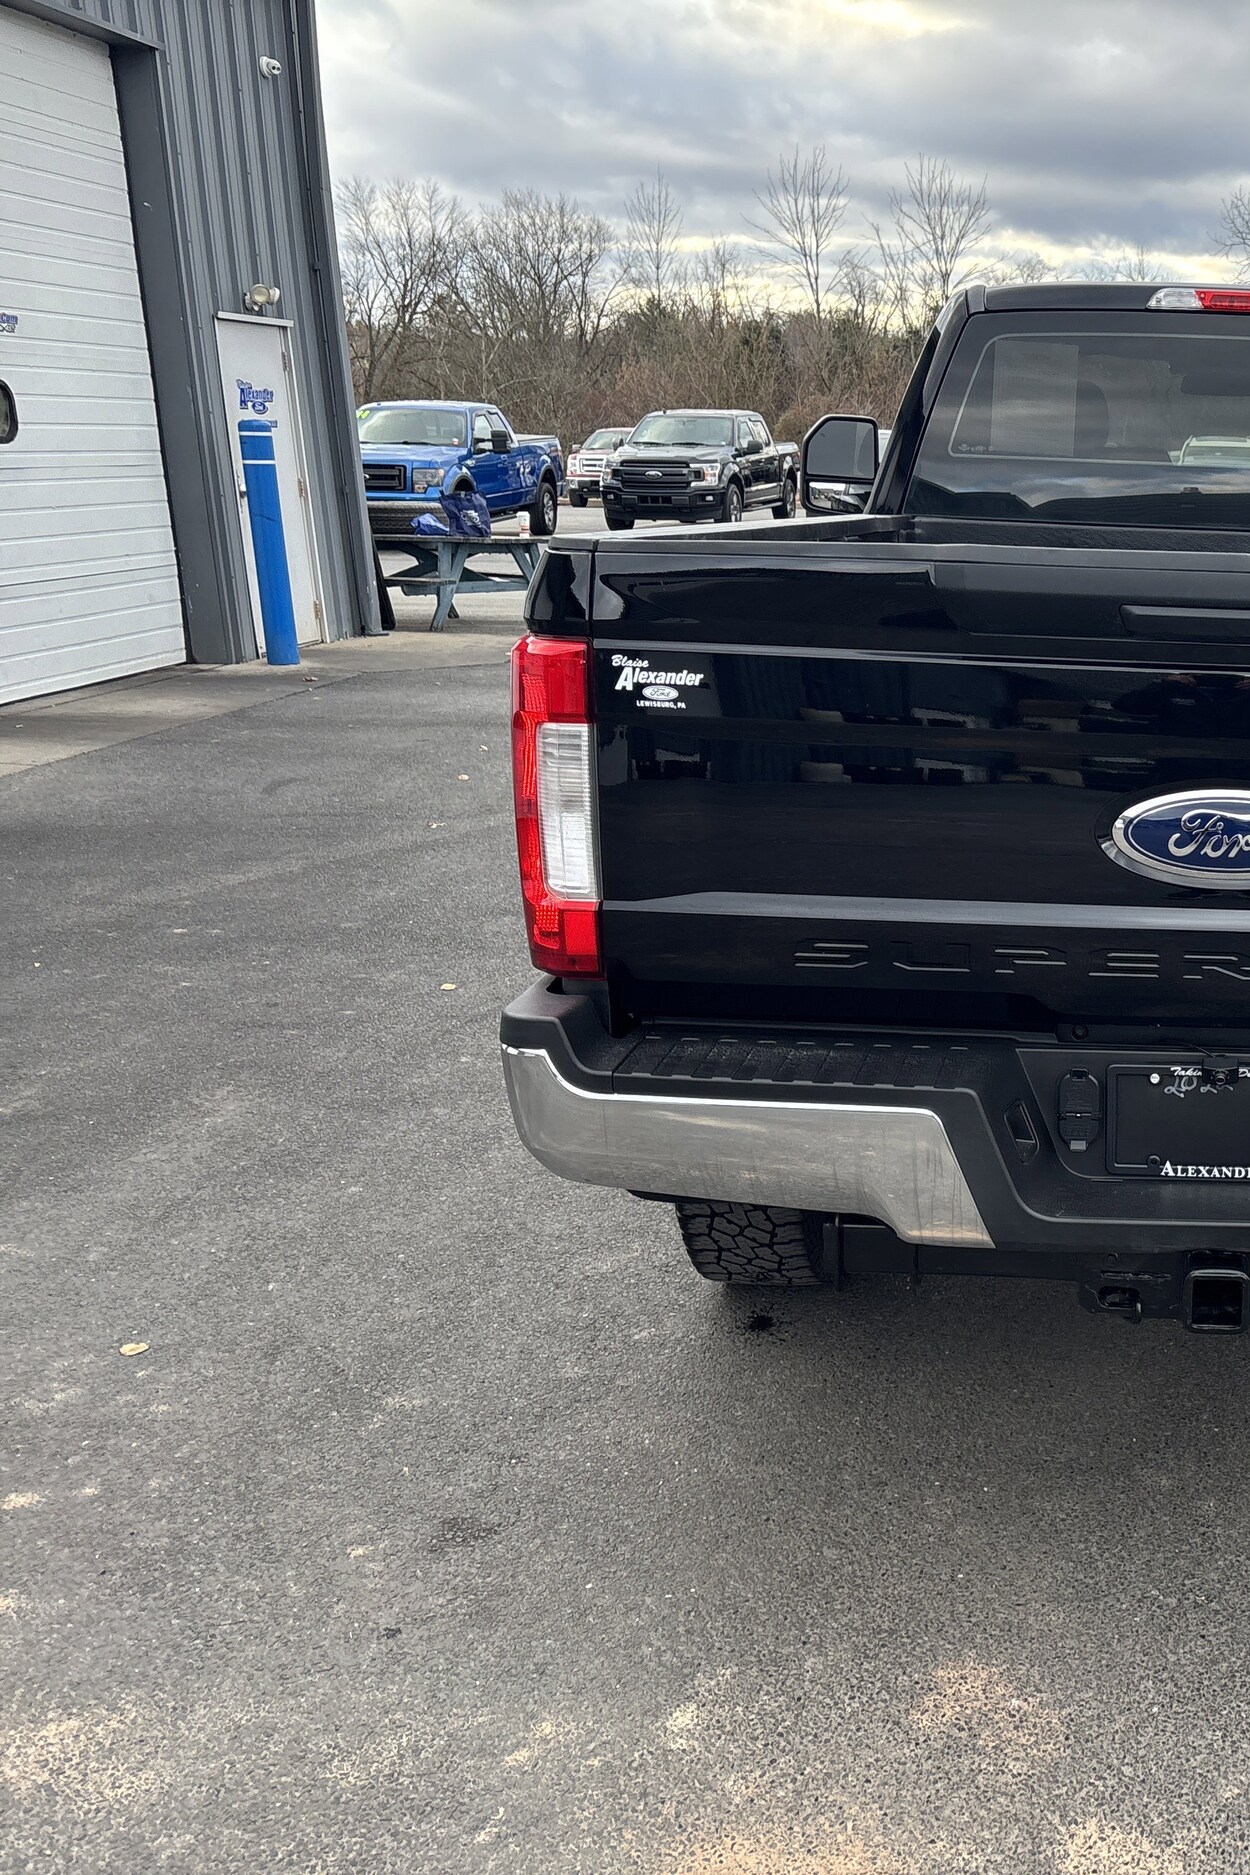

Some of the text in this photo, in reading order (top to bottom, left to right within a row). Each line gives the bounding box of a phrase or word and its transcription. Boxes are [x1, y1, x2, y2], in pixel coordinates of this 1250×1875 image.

[239, 387, 274, 410] Alexander
[611, 654, 649, 668] Blaise
[614, 667, 705, 692] Alexander
[636, 699, 677, 710] LEWISBURG,
